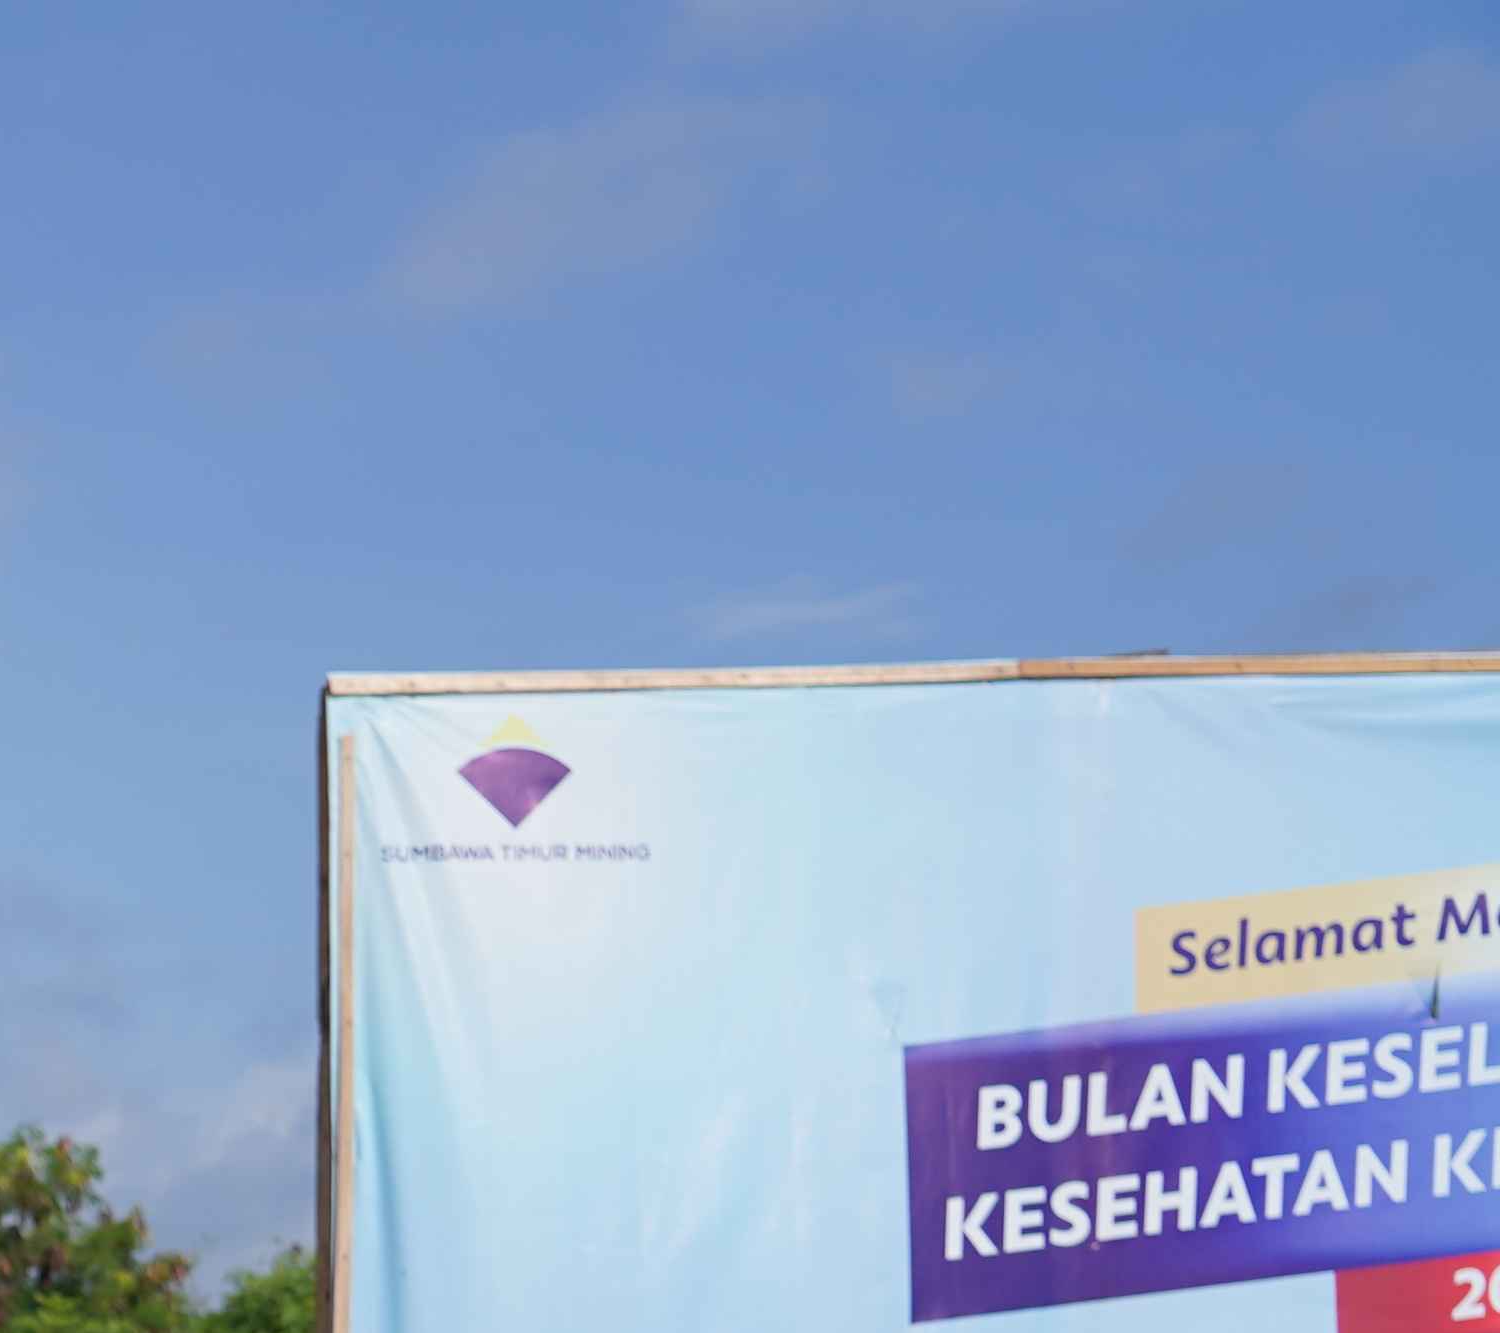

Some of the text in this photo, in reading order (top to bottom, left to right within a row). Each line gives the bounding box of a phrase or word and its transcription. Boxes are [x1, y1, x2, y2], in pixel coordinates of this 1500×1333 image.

[381, 844, 651, 862] SUMBAWA TIMUR MINING
[1169, 893, 1500, 975] Selamat M
[976, 1054, 1245, 1151] BULAN
[944, 1139, 1409, 1261] KESEHATAN
